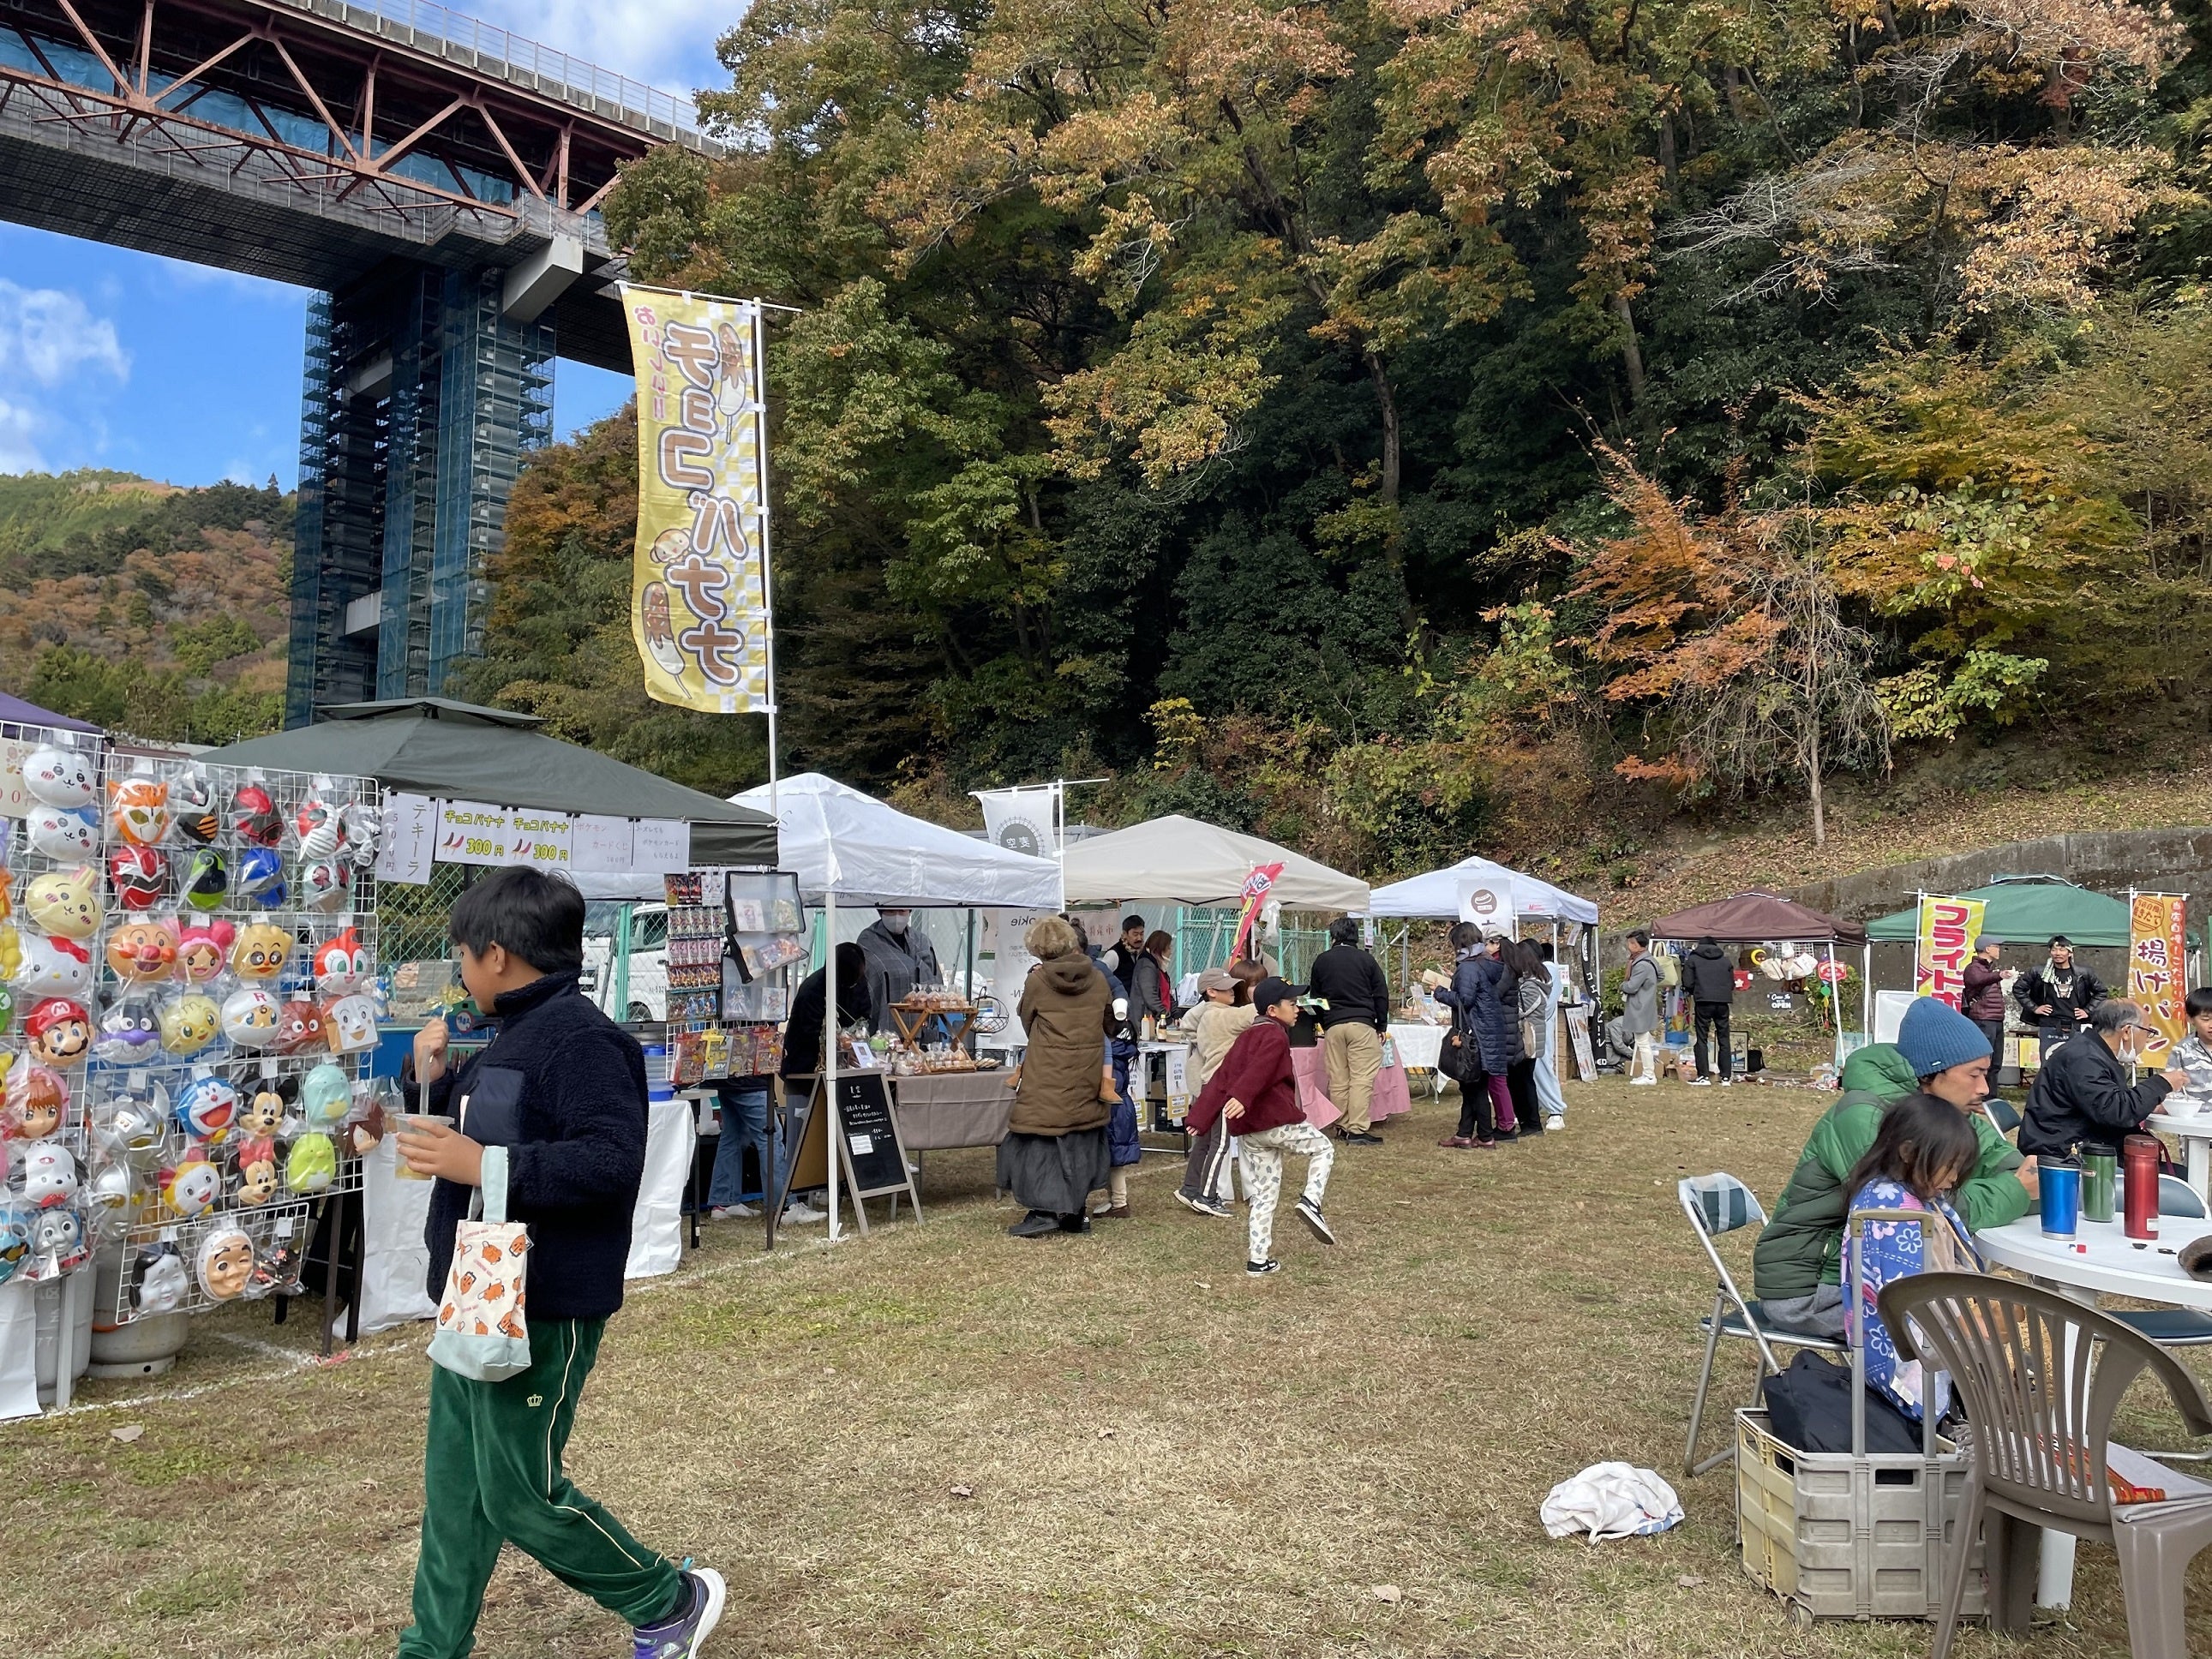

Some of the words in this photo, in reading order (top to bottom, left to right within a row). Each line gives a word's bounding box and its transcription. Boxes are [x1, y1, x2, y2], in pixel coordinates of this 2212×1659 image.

[444, 810, 505, 829] チョコバナナ
[513, 817, 568, 834] チョコバナナ
[406, 804, 427, 877] テキーラ
[465, 837, 504, 856] 300円
[533, 844, 568, 860] 300円
[254, 992, 267, 1002] R
[53, 1003, 68, 1015] M
